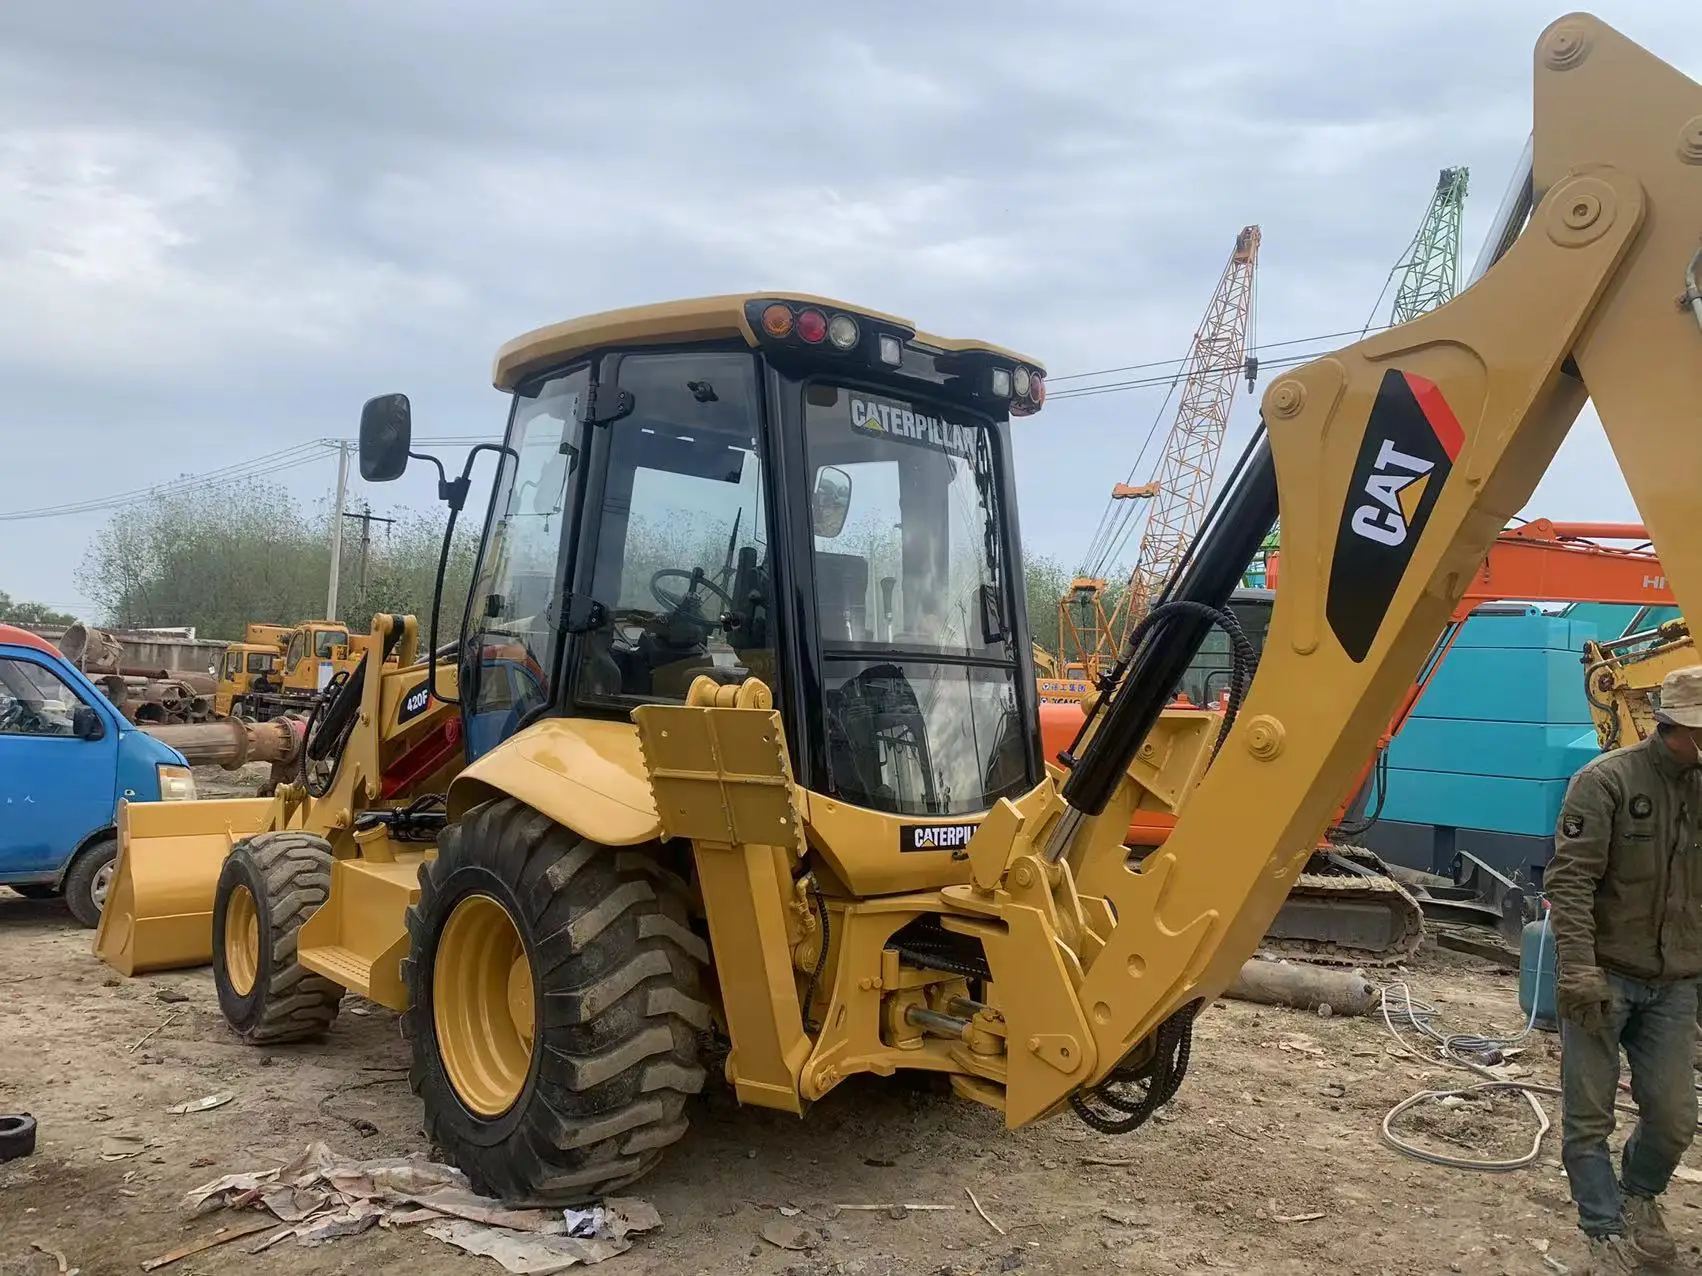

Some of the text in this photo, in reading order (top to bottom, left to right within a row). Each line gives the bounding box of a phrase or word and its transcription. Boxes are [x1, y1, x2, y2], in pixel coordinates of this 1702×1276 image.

[1351, 438, 1435, 546] CAT
[1643, 575, 1666, 590] HI
[407, 689, 428, 711] 420F
